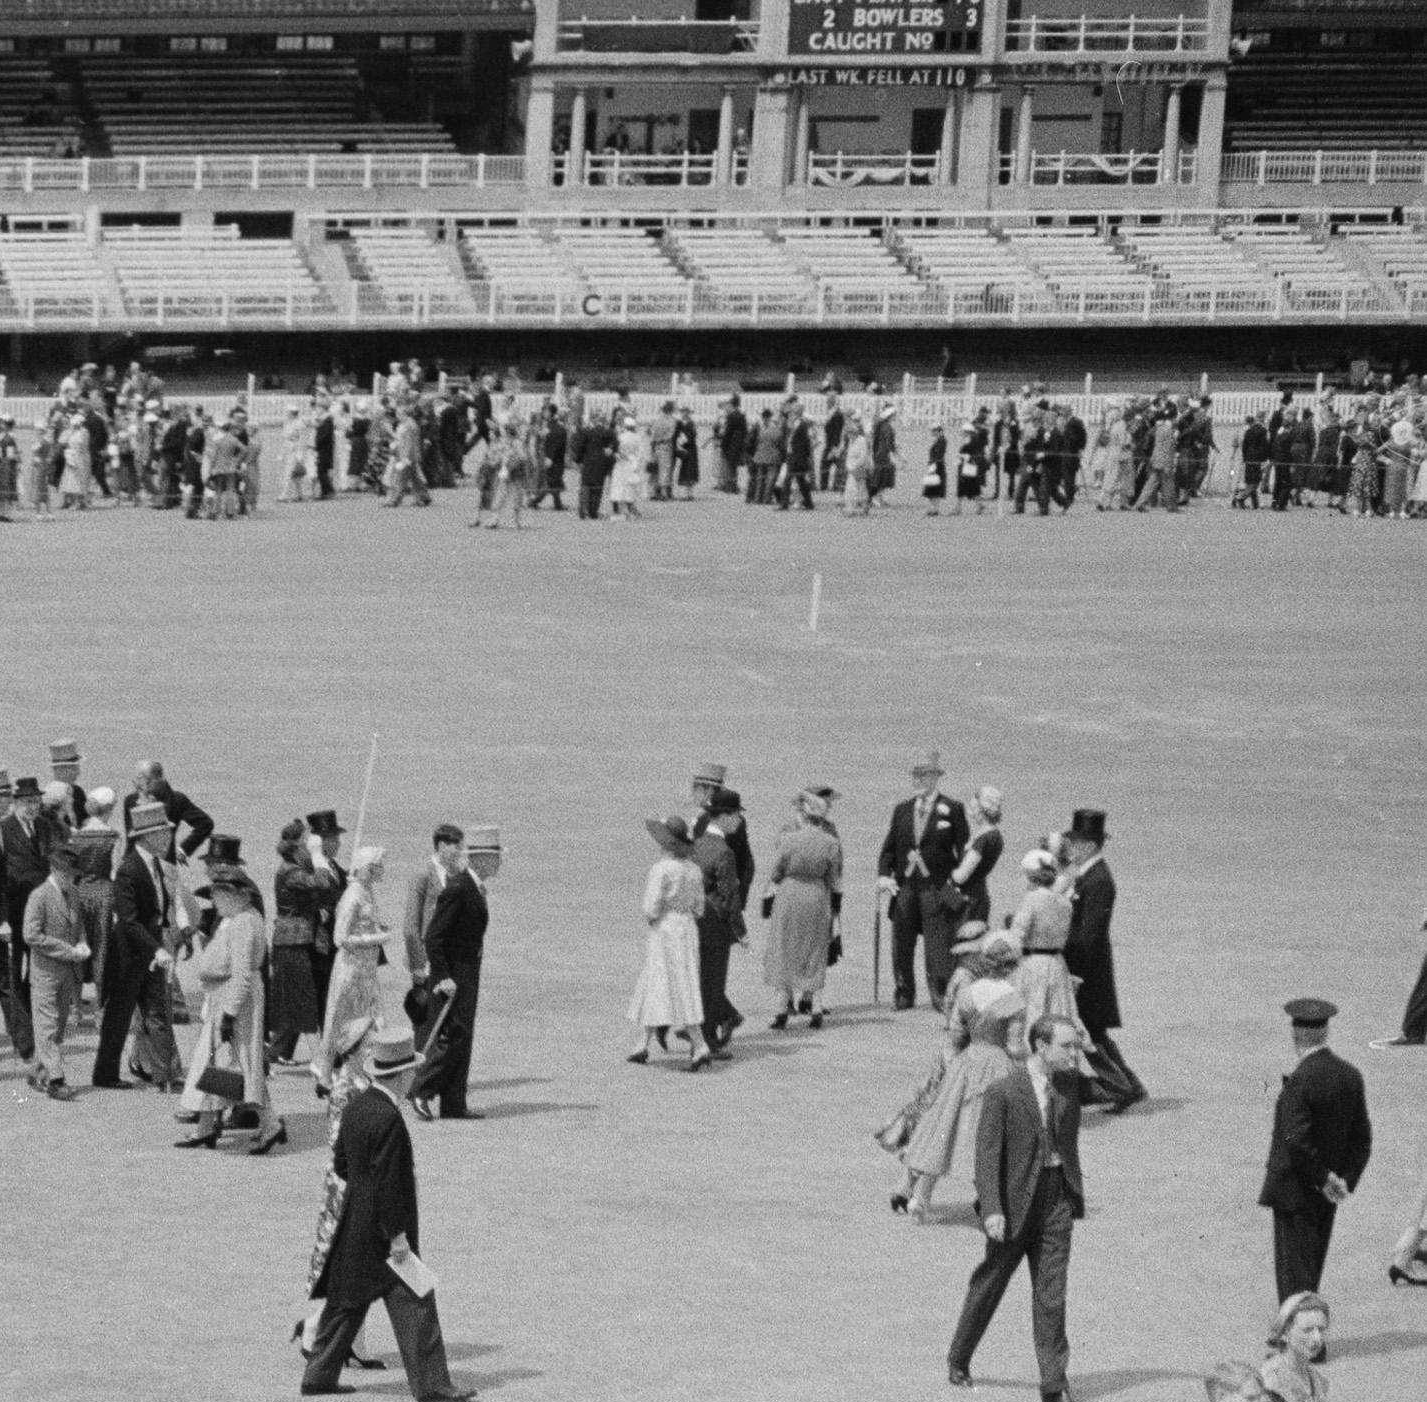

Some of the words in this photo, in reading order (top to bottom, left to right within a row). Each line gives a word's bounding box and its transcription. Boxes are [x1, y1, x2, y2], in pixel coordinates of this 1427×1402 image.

[823, 9, 836, 28] 2
[853, 8, 944, 27] BOWLERS
[966, 8, 978, 27] 3
[809, 32, 896, 50] CAUGHT
[788, 69, 828, 85] LAST
[867, 70, 905, 85] FELL
[909, 69, 932, 85] AT
[582, 295, 602, 316] C
